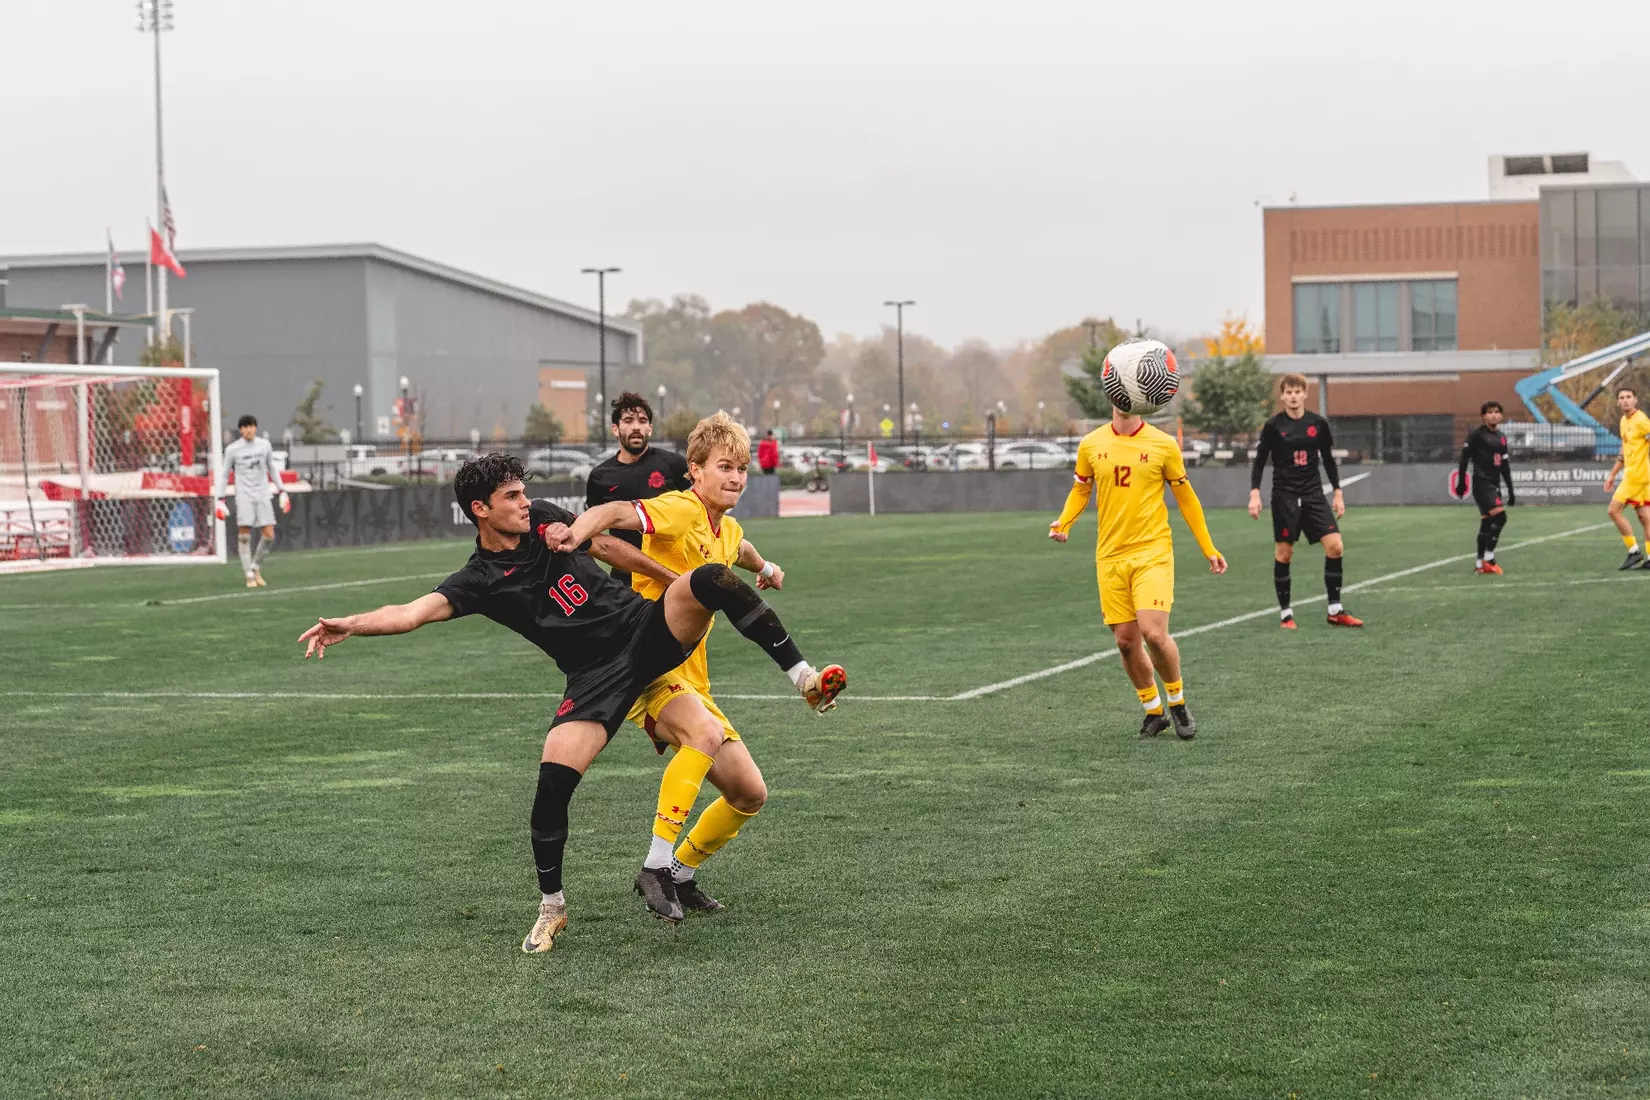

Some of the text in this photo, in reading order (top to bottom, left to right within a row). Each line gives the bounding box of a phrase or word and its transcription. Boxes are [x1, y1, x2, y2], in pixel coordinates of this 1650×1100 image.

[1140, 453, 1148, 462] M
[1113, 465, 1131, 487] 12
[1535, 468, 1570, 481] STATE
[549, 574, 588, 616] 16
